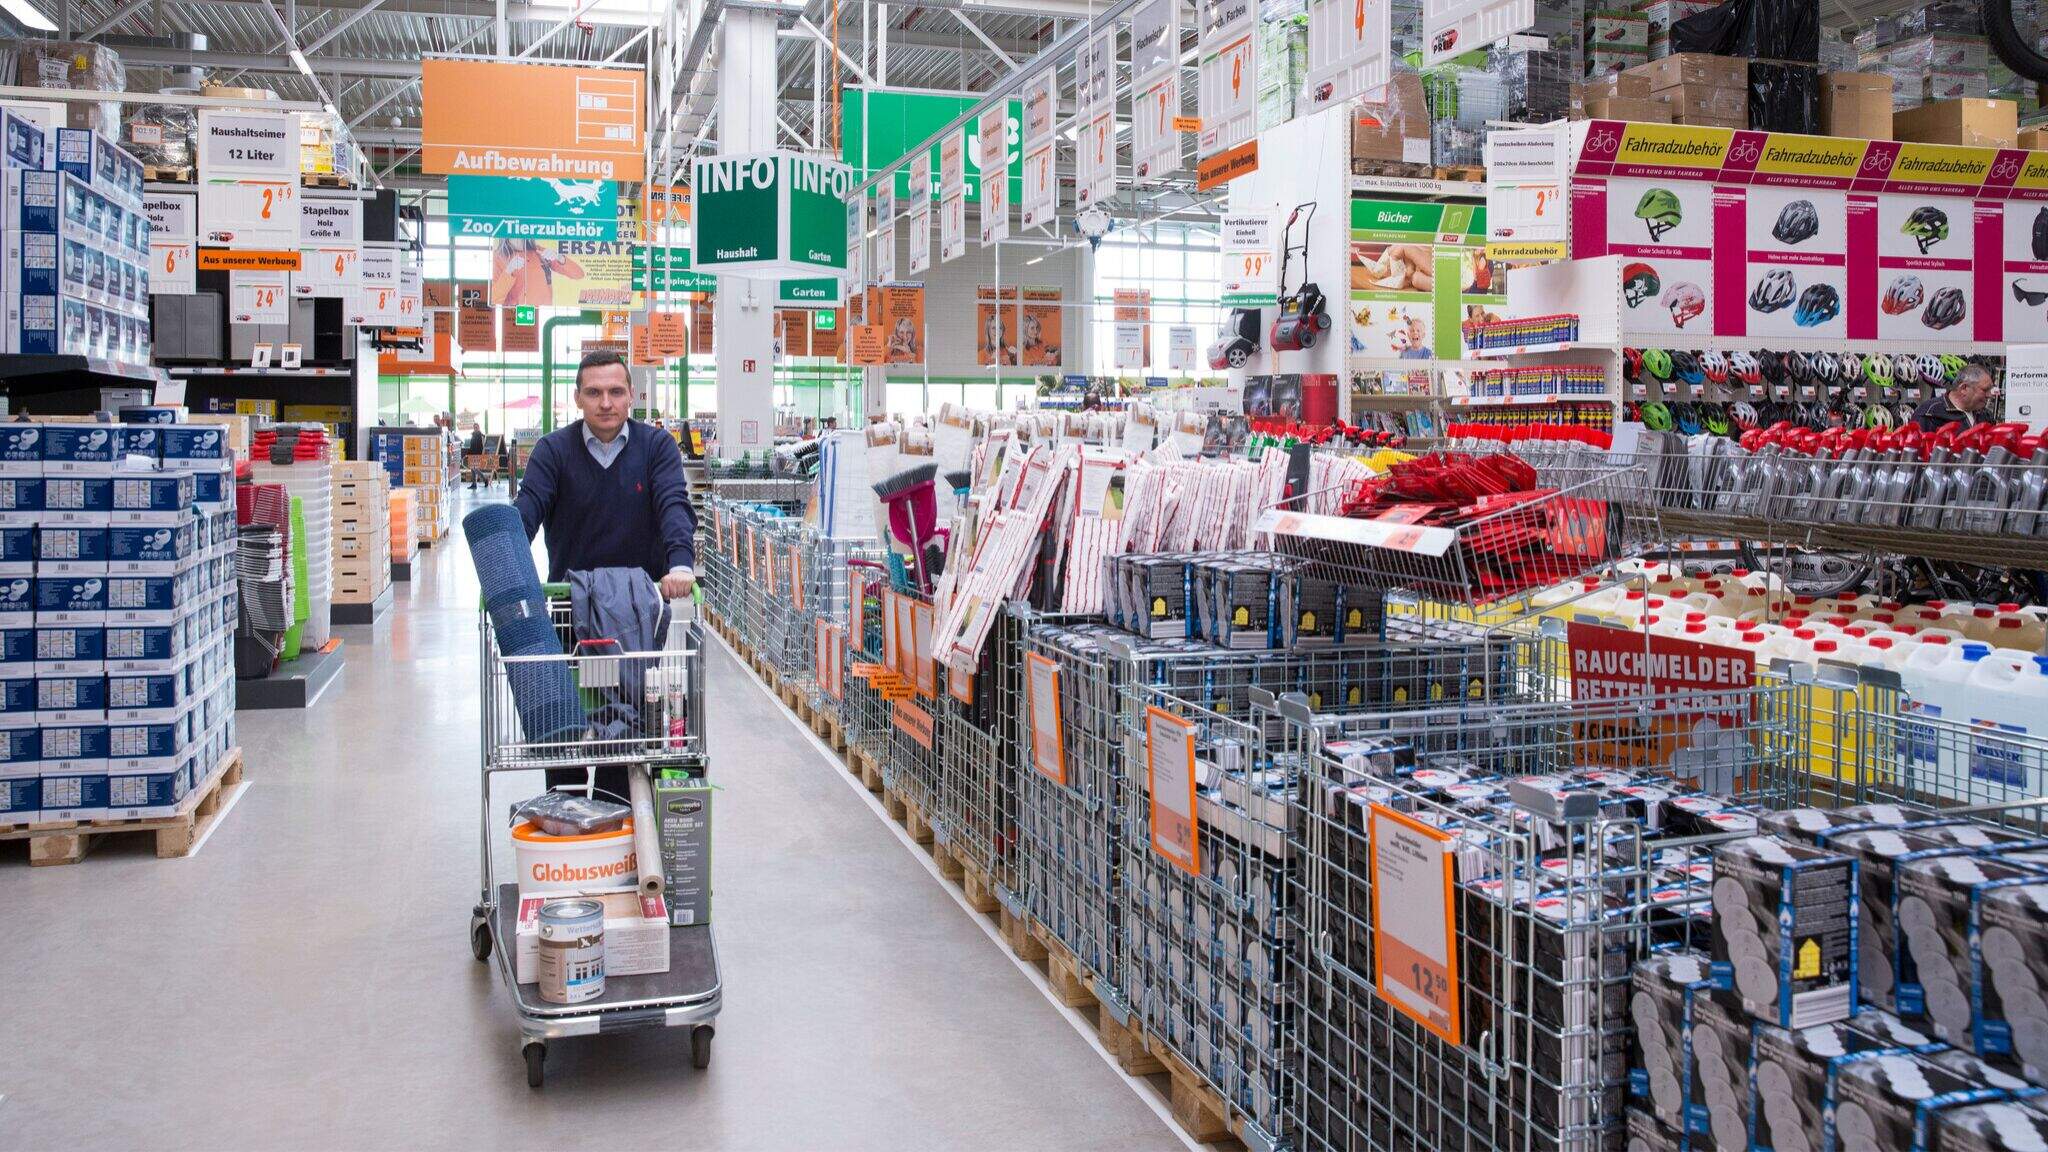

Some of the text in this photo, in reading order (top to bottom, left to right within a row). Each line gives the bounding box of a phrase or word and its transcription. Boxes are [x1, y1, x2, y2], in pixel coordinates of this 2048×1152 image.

[211, 127, 286, 139] Haushaltseimer
[229, 149, 275, 161] 12 Liter
[1625, 138, 1723, 157] Fahrradzubehör
[1766, 147, 1858, 167] Fahrradzubehör
[453, 151, 614, 179] Aufbewahrung
[1231, 153, 1256, 169] Werbung
[1900, 157, 1986, 174] Fahrradzubehör
[701, 158, 775, 194] INFO
[794, 158, 846, 204] INFO
[143, 202, 180, 211] apelbox
[262, 189, 273, 219] 2
[303, 206, 349, 217] Stapelbox
[1535, 191, 1545, 216] 2
[1377, 211, 1412, 223] Bücher
[310, 229, 331, 237] Größe
[462, 218, 603, 237] Zoo/Tierzubehör
[558, 240, 636, 254] ERSATZ
[717, 249, 757, 259] Haushalt
[809, 250, 831, 262] Garten
[166, 250, 174, 273] 6
[204, 256, 219, 264] Aus
[258, 256, 297, 267] Werbung
[335, 255, 344, 276] 4
[1245, 257, 1262, 276] 99
[256, 290, 273, 307] 24
[792, 288, 825, 297] Garten
[1575, 649, 1747, 685] RAUCHMELDER
[1577, 678, 1656, 708] RETTEN
[532, 852, 637, 883] Globusweiß
[1412, 962, 1433, 997] 12
